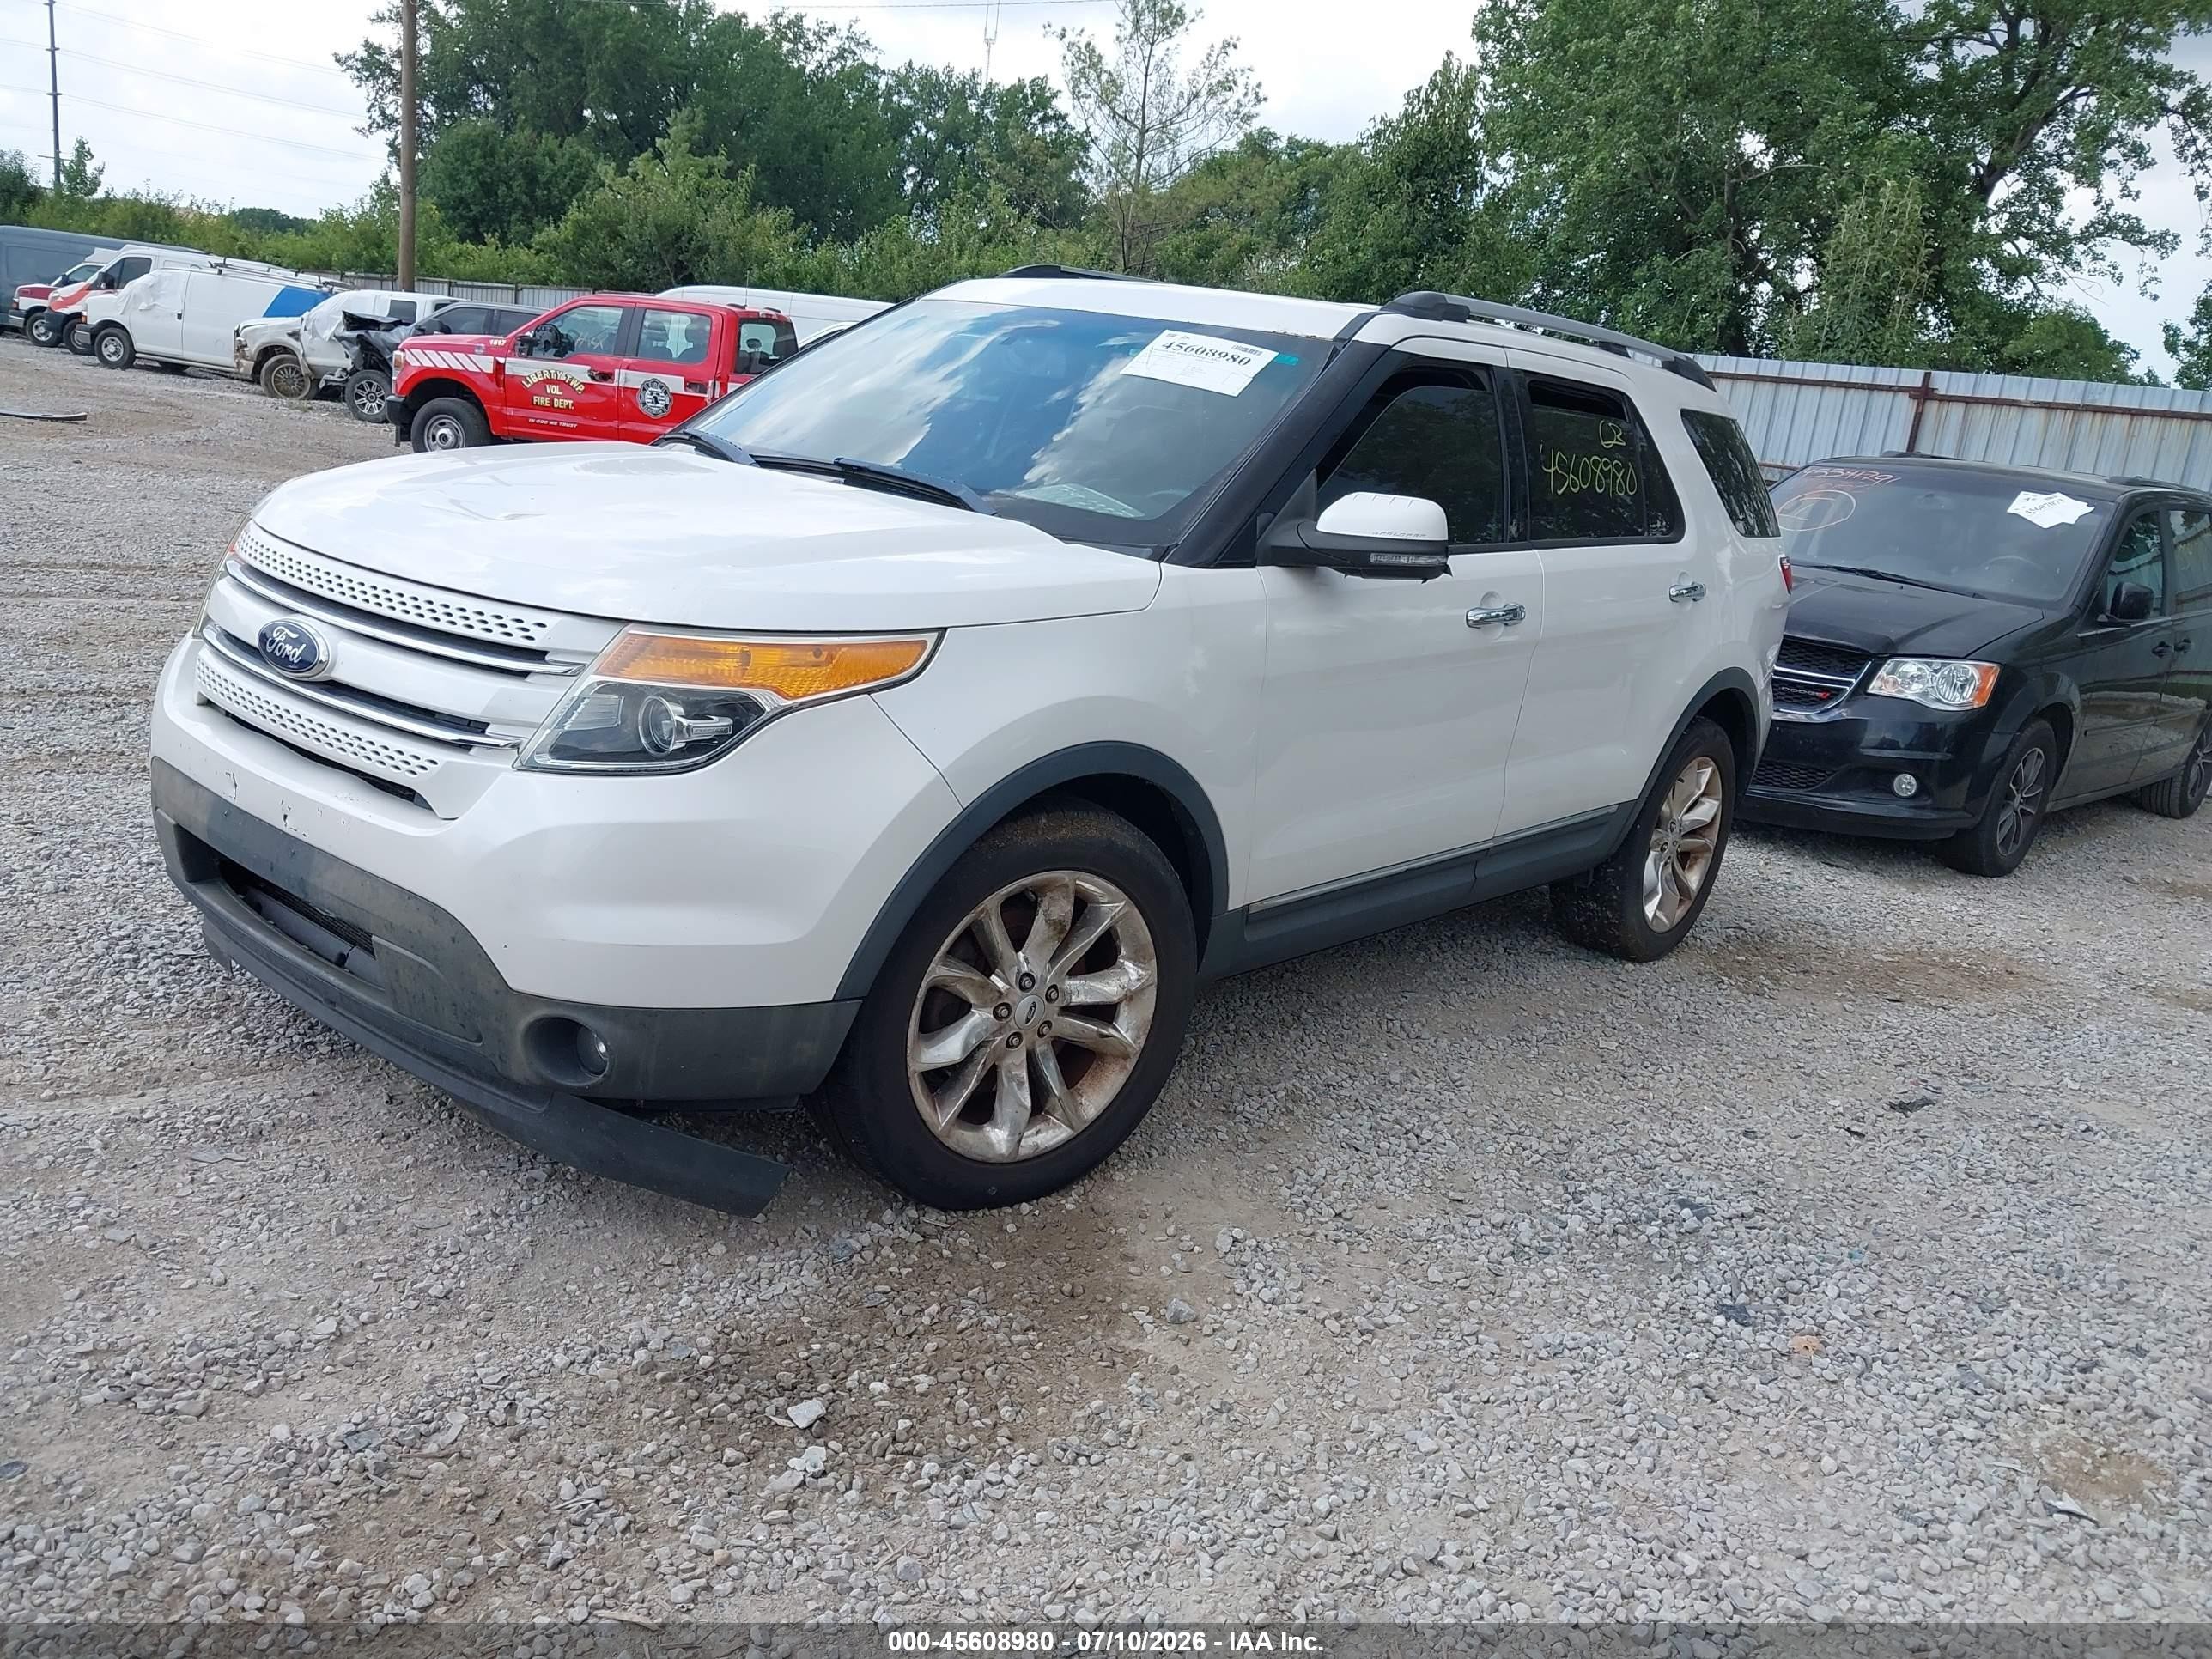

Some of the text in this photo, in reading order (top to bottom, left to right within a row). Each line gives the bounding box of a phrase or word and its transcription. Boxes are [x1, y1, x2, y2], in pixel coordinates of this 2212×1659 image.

[1162, 342, 1252, 367] 45608980
[521, 369, 586, 394] LIBERTY TWP.
[532, 395, 574, 410] FIRE DEPT.
[1540, 440, 1638, 498] 45608980
[266, 626, 307, 664] Ford
